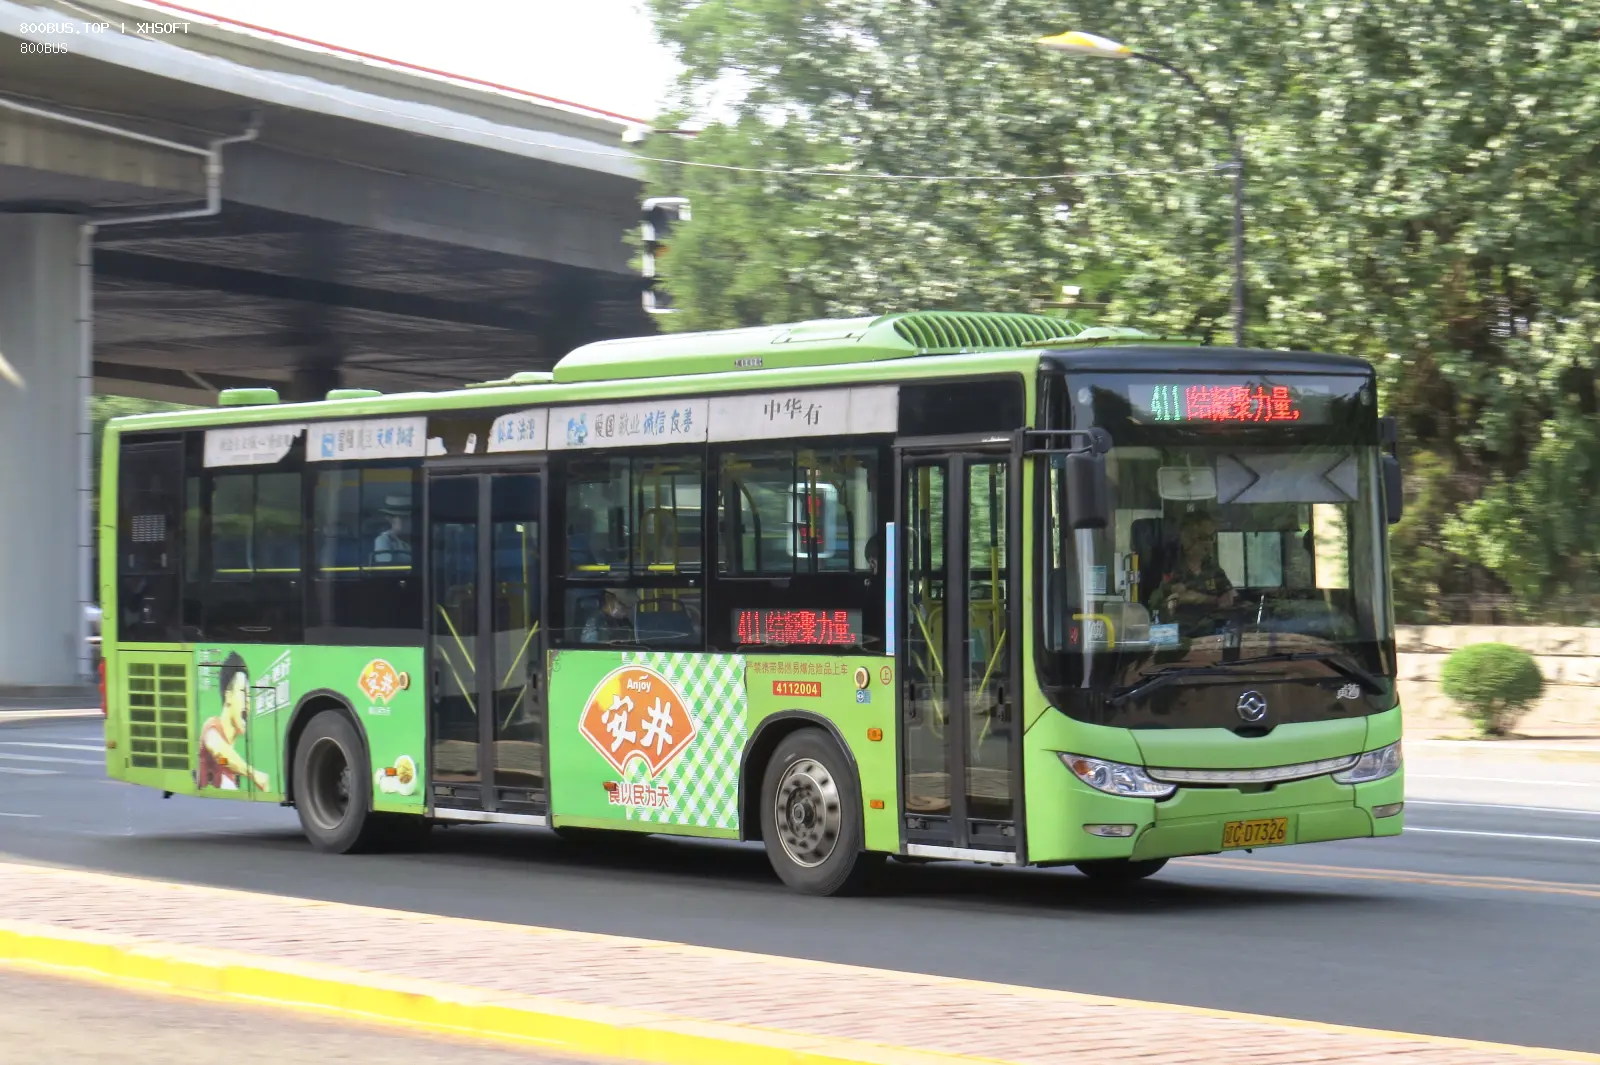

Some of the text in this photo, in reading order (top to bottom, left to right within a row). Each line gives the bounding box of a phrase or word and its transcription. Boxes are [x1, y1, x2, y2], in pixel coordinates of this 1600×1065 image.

[1150, 385, 1181, 421] 411
[737, 611, 761, 644] 411
[626, 677, 652, 693] Anjoy
[776, 682, 819, 695] 4112004
[601, 694, 674, 756] 安井
